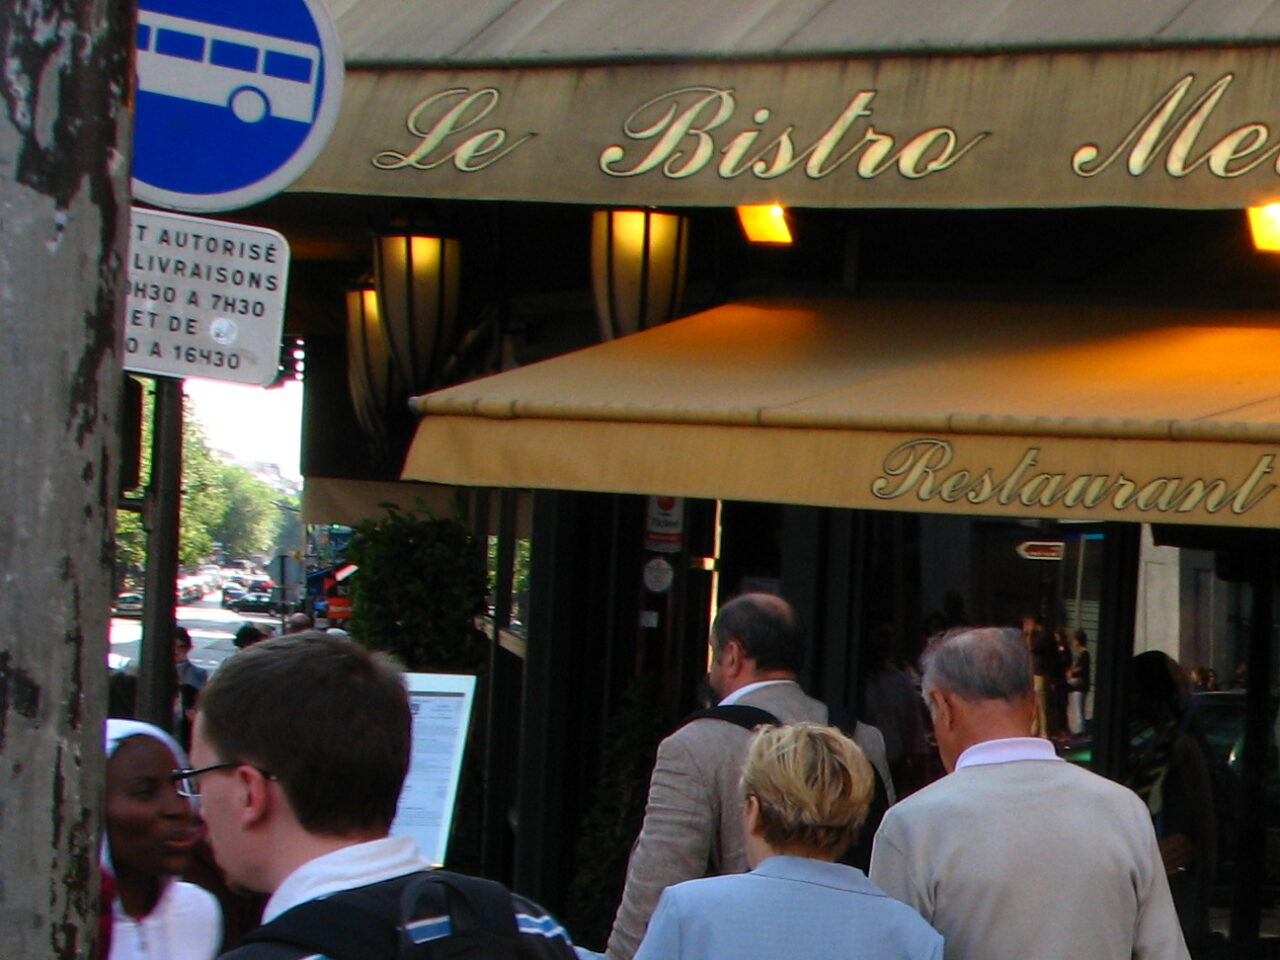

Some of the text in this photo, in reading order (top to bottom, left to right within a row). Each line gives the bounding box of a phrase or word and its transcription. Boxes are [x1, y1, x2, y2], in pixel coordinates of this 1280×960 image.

[372, 86, 537, 172] Le
[599, 86, 992, 181] Bistro
[158, 228, 278, 264] AUTORISÉ
[133, 252, 279, 292] LIVRAISONS
[131, 308, 198, 336] ET DE
[187, 290, 200, 308] A
[210, 294, 266, 318] 7H30
[149, 343, 163, 359] A
[173, 346, 241, 370] 16H30
[871, 438, 1278, 515] Restaurant
